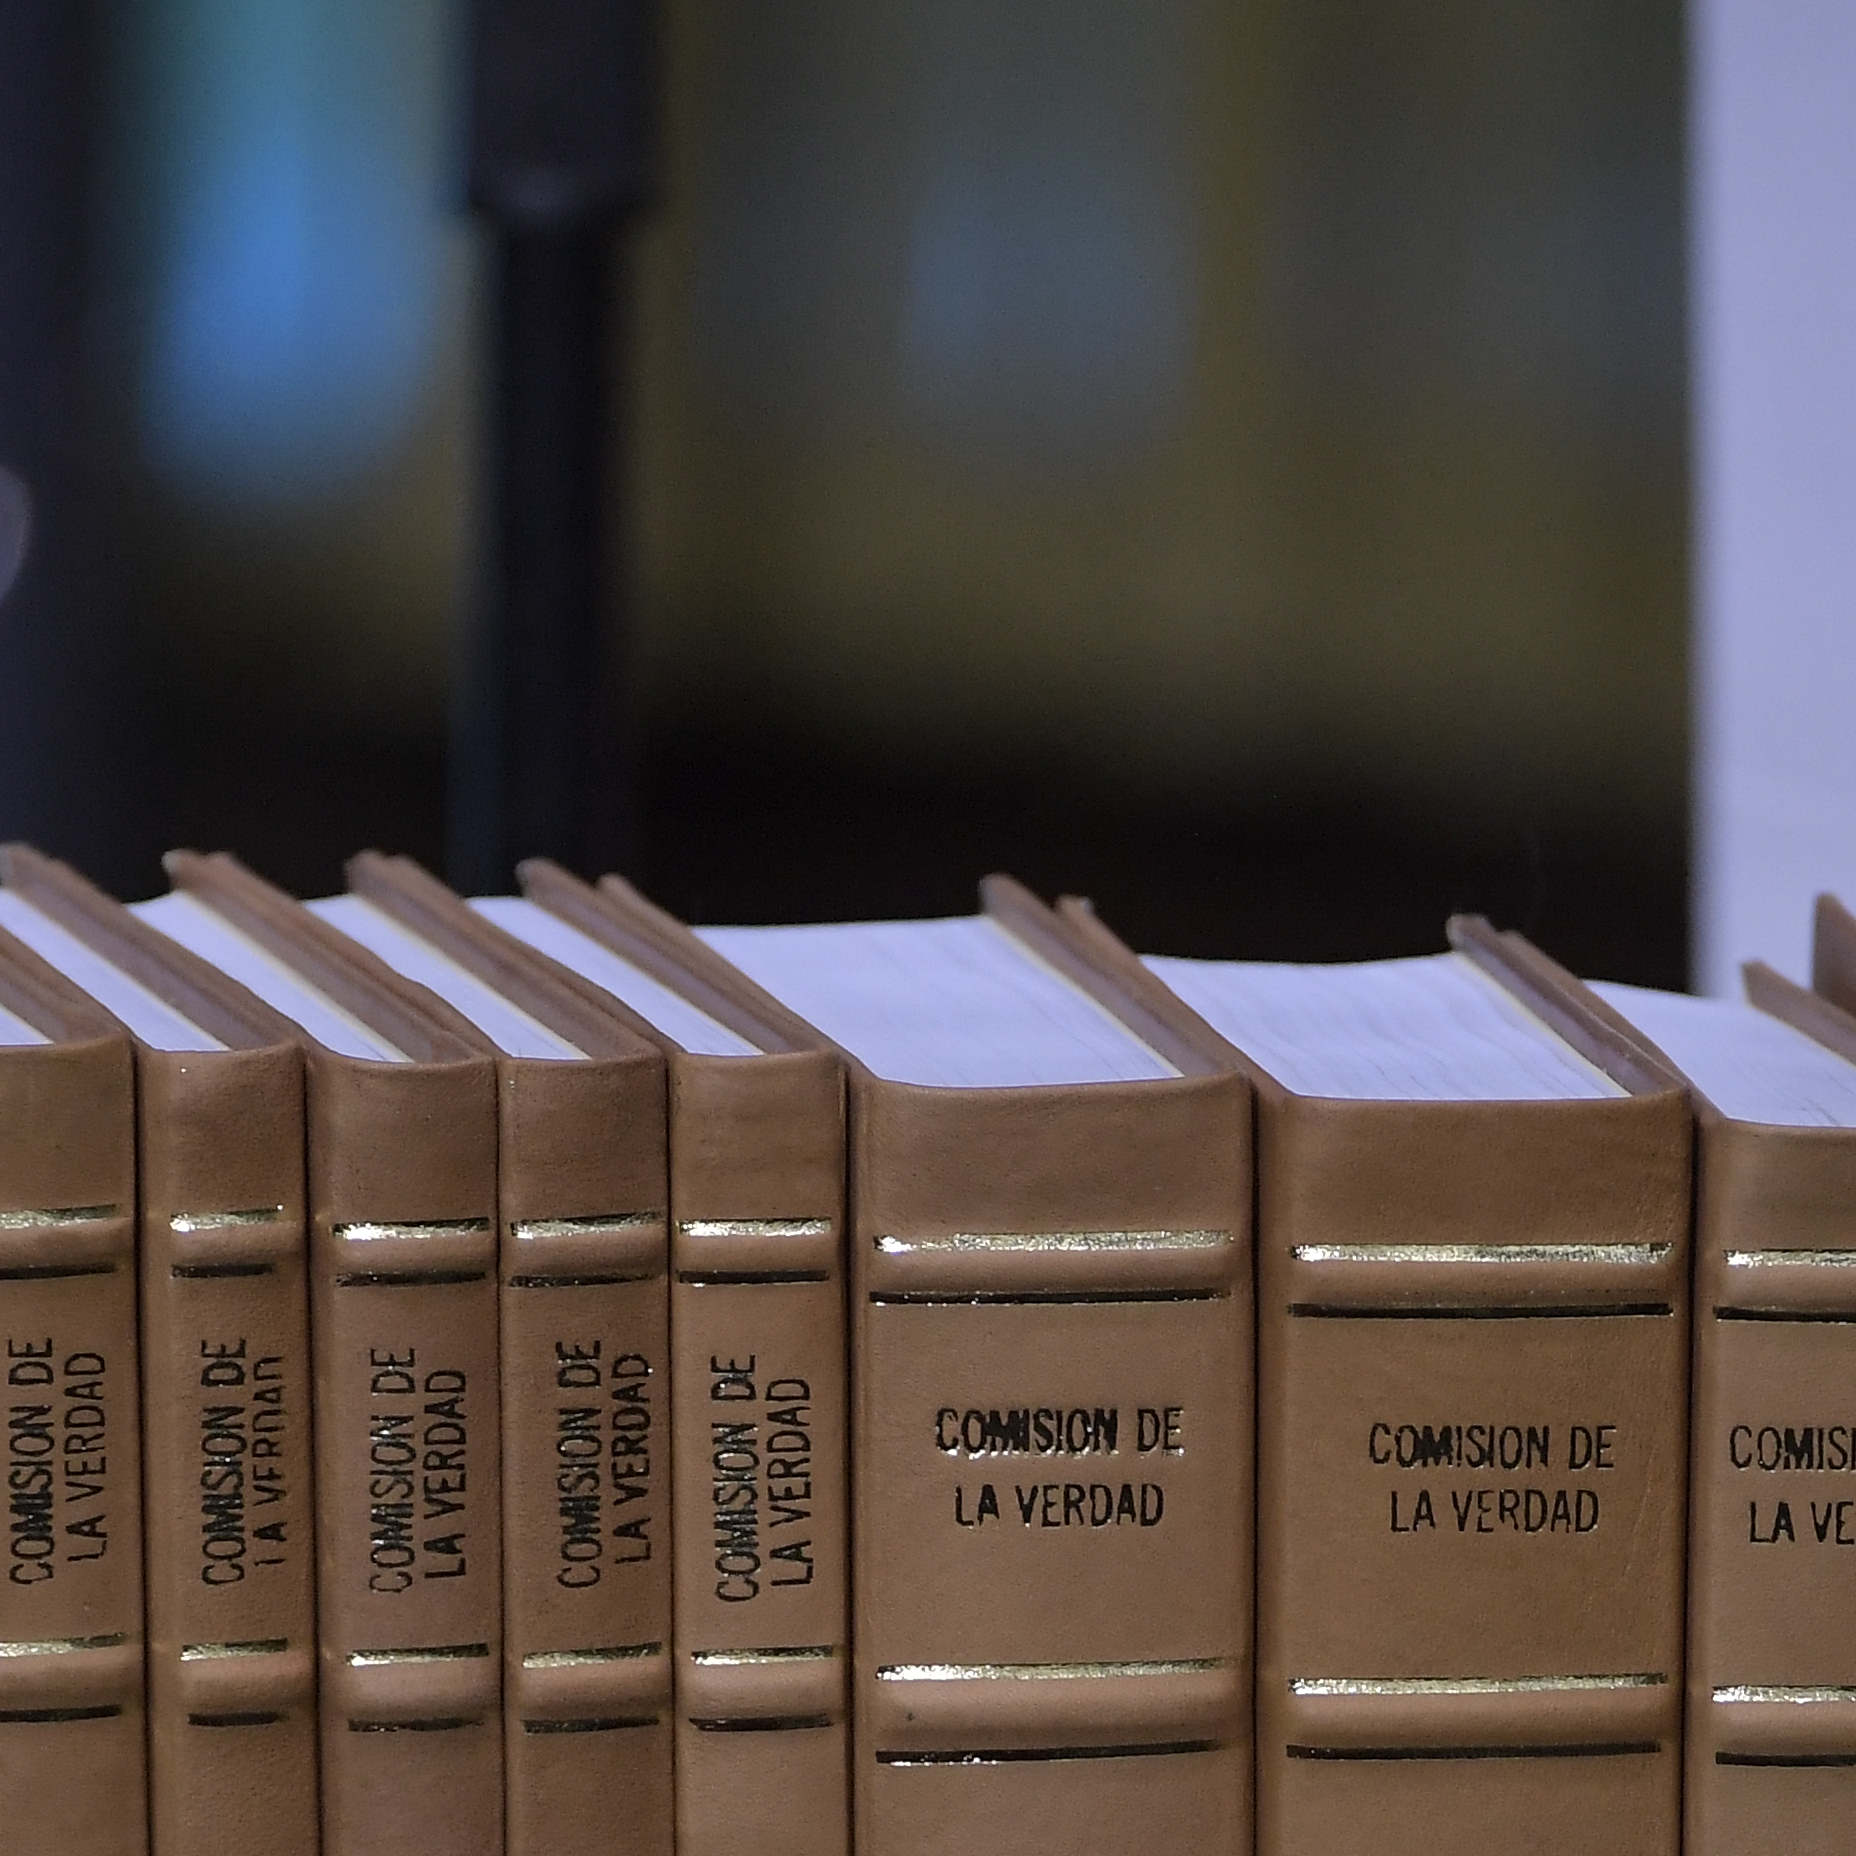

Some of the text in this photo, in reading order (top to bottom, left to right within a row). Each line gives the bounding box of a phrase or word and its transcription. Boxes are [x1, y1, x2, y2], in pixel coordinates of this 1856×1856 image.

[7, 1336, 55, 1585] COMISION DE
[63, 1350, 108, 1561] LA VERDAD
[201, 1338, 247, 1588] COMISION DE
[369, 1347, 416, 1594] COMISION DE
[421, 1369, 467, 1580] LA VERDAD
[556, 1338, 603, 1590] COMISION DE
[612, 1353, 652, 1563] LA VERDAD
[711, 1355, 761, 1603] COMISION DE
[765, 1377, 816, 1588] LA VERDAD
[936, 1407, 1185, 1459] COMISION DE
[955, 1483, 1164, 1527] LA VERDAD
[1369, 1422, 1617, 1469] COMISION DE
[1391, 1489, 1600, 1533] LA VERDAD
[1749, 1502, 1795, 1544] LA
